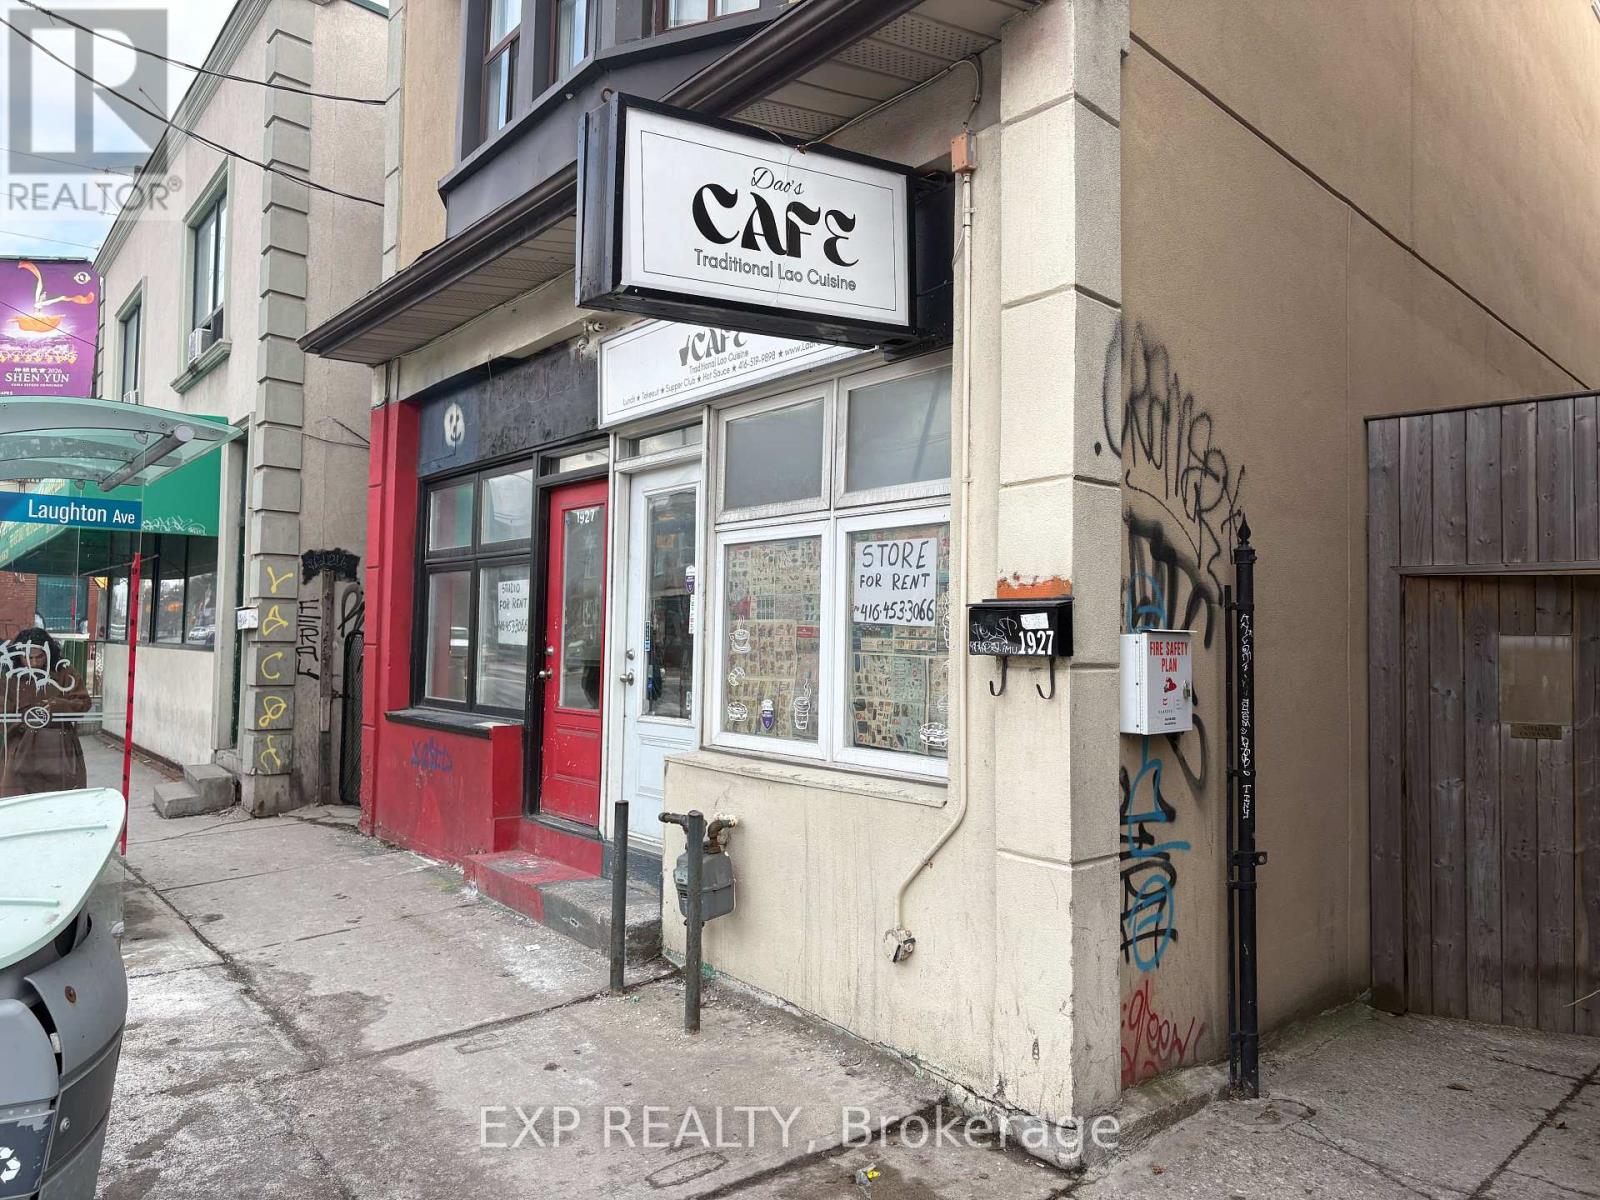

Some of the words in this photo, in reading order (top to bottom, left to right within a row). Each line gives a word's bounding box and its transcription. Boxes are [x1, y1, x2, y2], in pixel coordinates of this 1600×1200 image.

[751, 167, 804, 195] Dao's
[692, 183, 859, 268] CAFE
[694, 248, 774, 278] Traditional
[777, 263, 803, 283] Lao
[806, 268, 857, 292] Cuisine
[690, 356, 717, 374] Traditional
[717, 356, 728, 366] Lao
[728, 350, 749, 362] Cuisine
[5, 372, 40, 383] SHEN
[43, 373, 70, 384] YUN
[623, 394, 636, 406] Lunch
[642, 388, 660, 401] Takeout
[665, 380, 683, 393] Supper
[683, 376, 696, 387] Club
[702, 372, 712, 382] Hot
[713, 367, 731, 379] Sauce
[28, 499, 107, 524] Laughton
[112, 509, 135, 525] Ave
[577, 509, 595, 524] 1927
[862, 540, 930, 570] STORE
[859, 572, 882, 589] FOR
[892, 572, 931, 591] RENT
[500, 599, 510, 610] FOR
[512, 597, 528, 608] RENT
[1018, 630, 1054, 656] 1927
[1150, 641, 1163, 656] FIRE
[1166, 641, 1188, 656] SAFETY
[1161, 658, 1177, 673] PLAN
